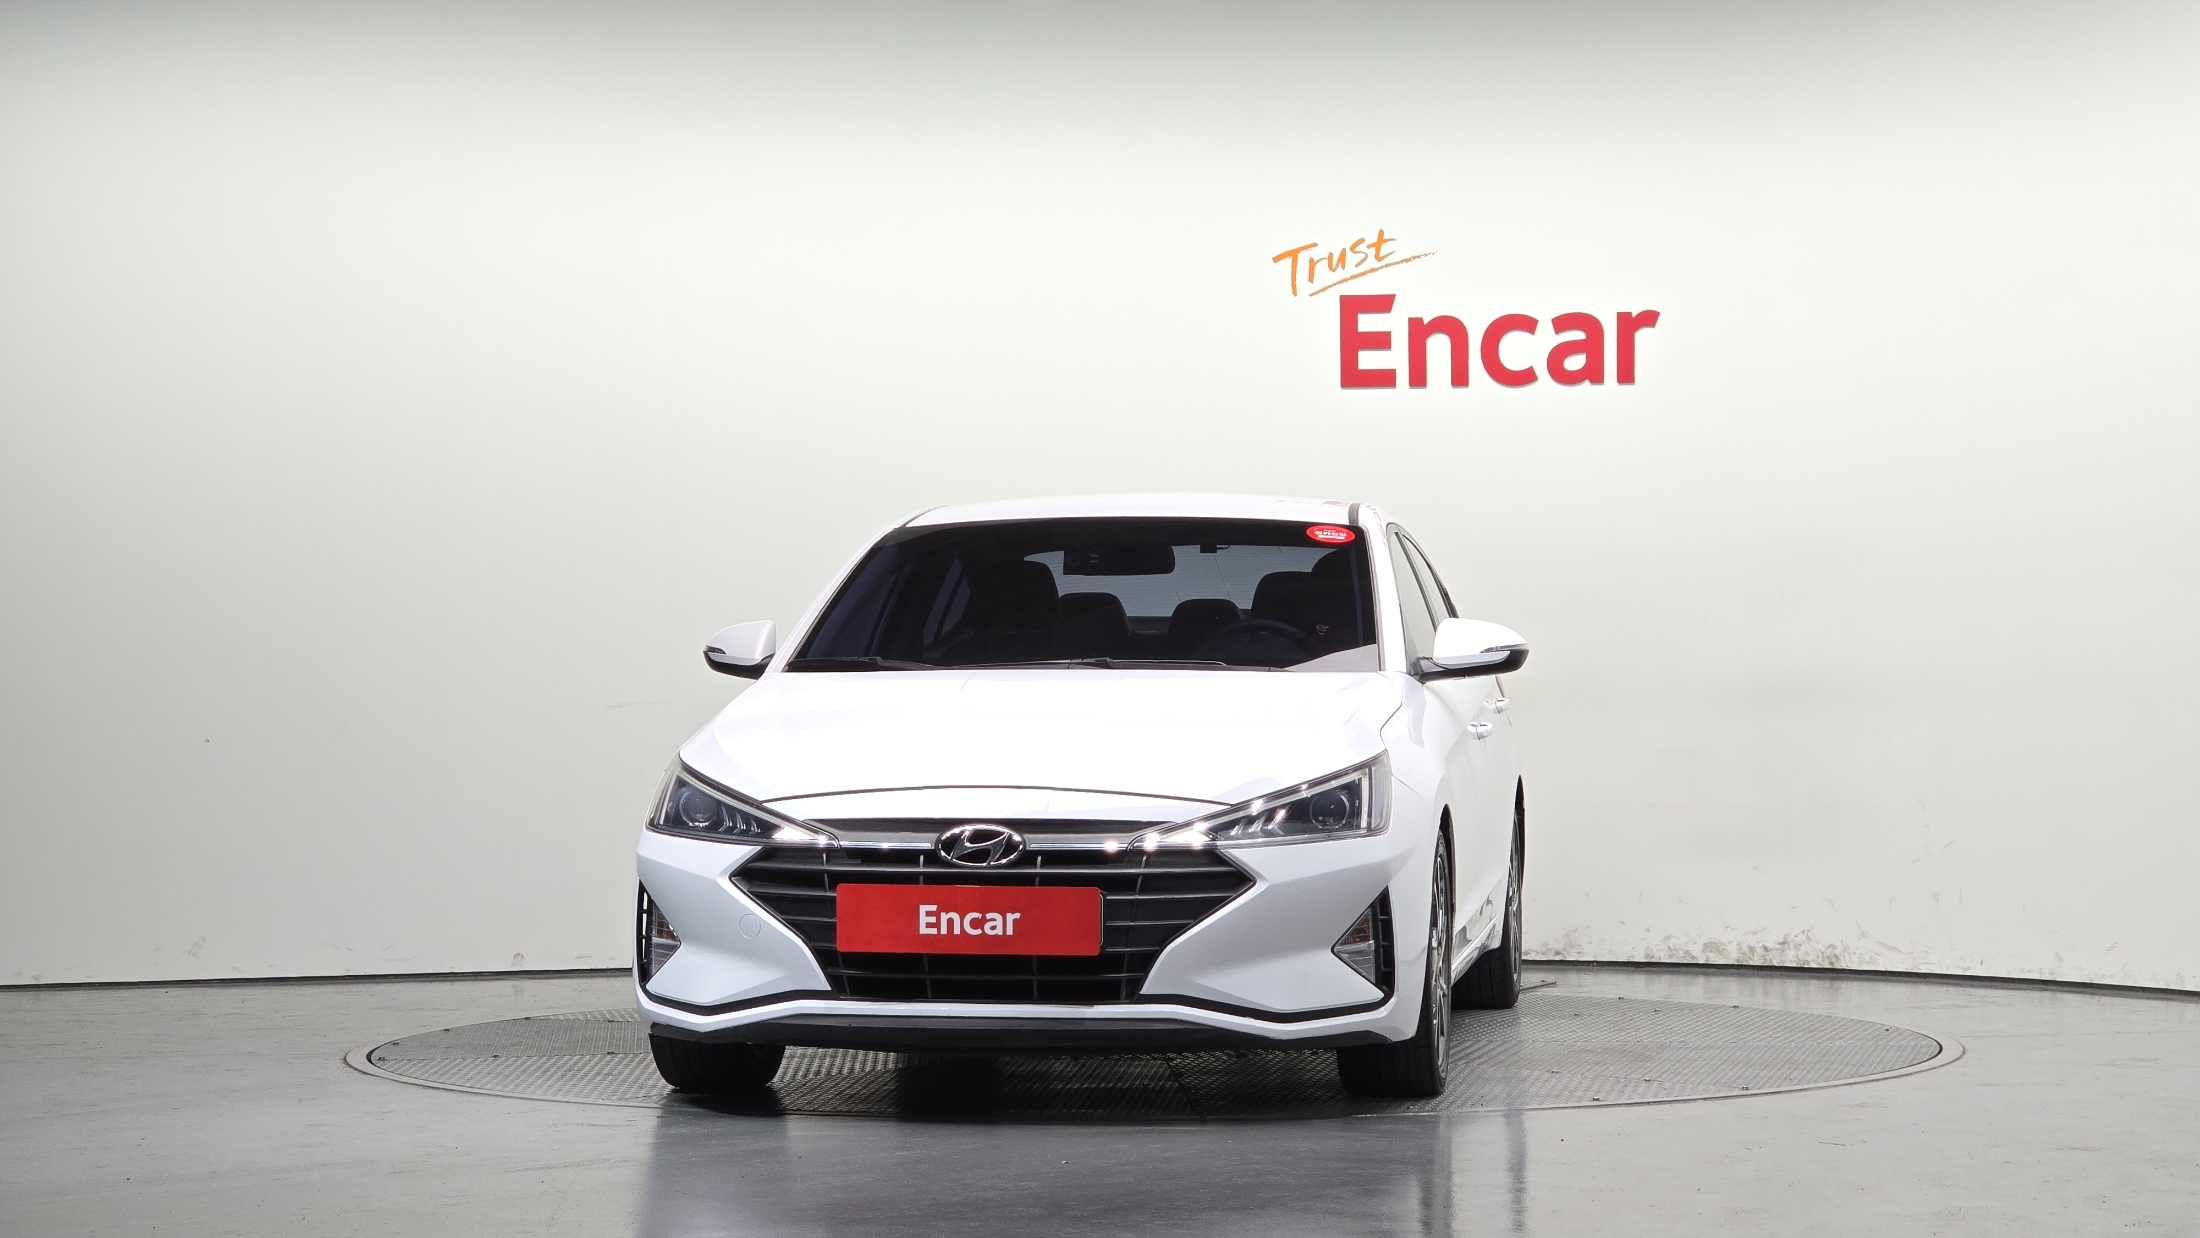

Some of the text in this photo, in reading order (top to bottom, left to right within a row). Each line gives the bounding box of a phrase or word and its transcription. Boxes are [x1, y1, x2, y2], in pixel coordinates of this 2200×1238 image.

[1272, 229, 1397, 296] Trust
[1339, 294, 1661, 389] Encar
[918, 904, 1022, 936] Encar
